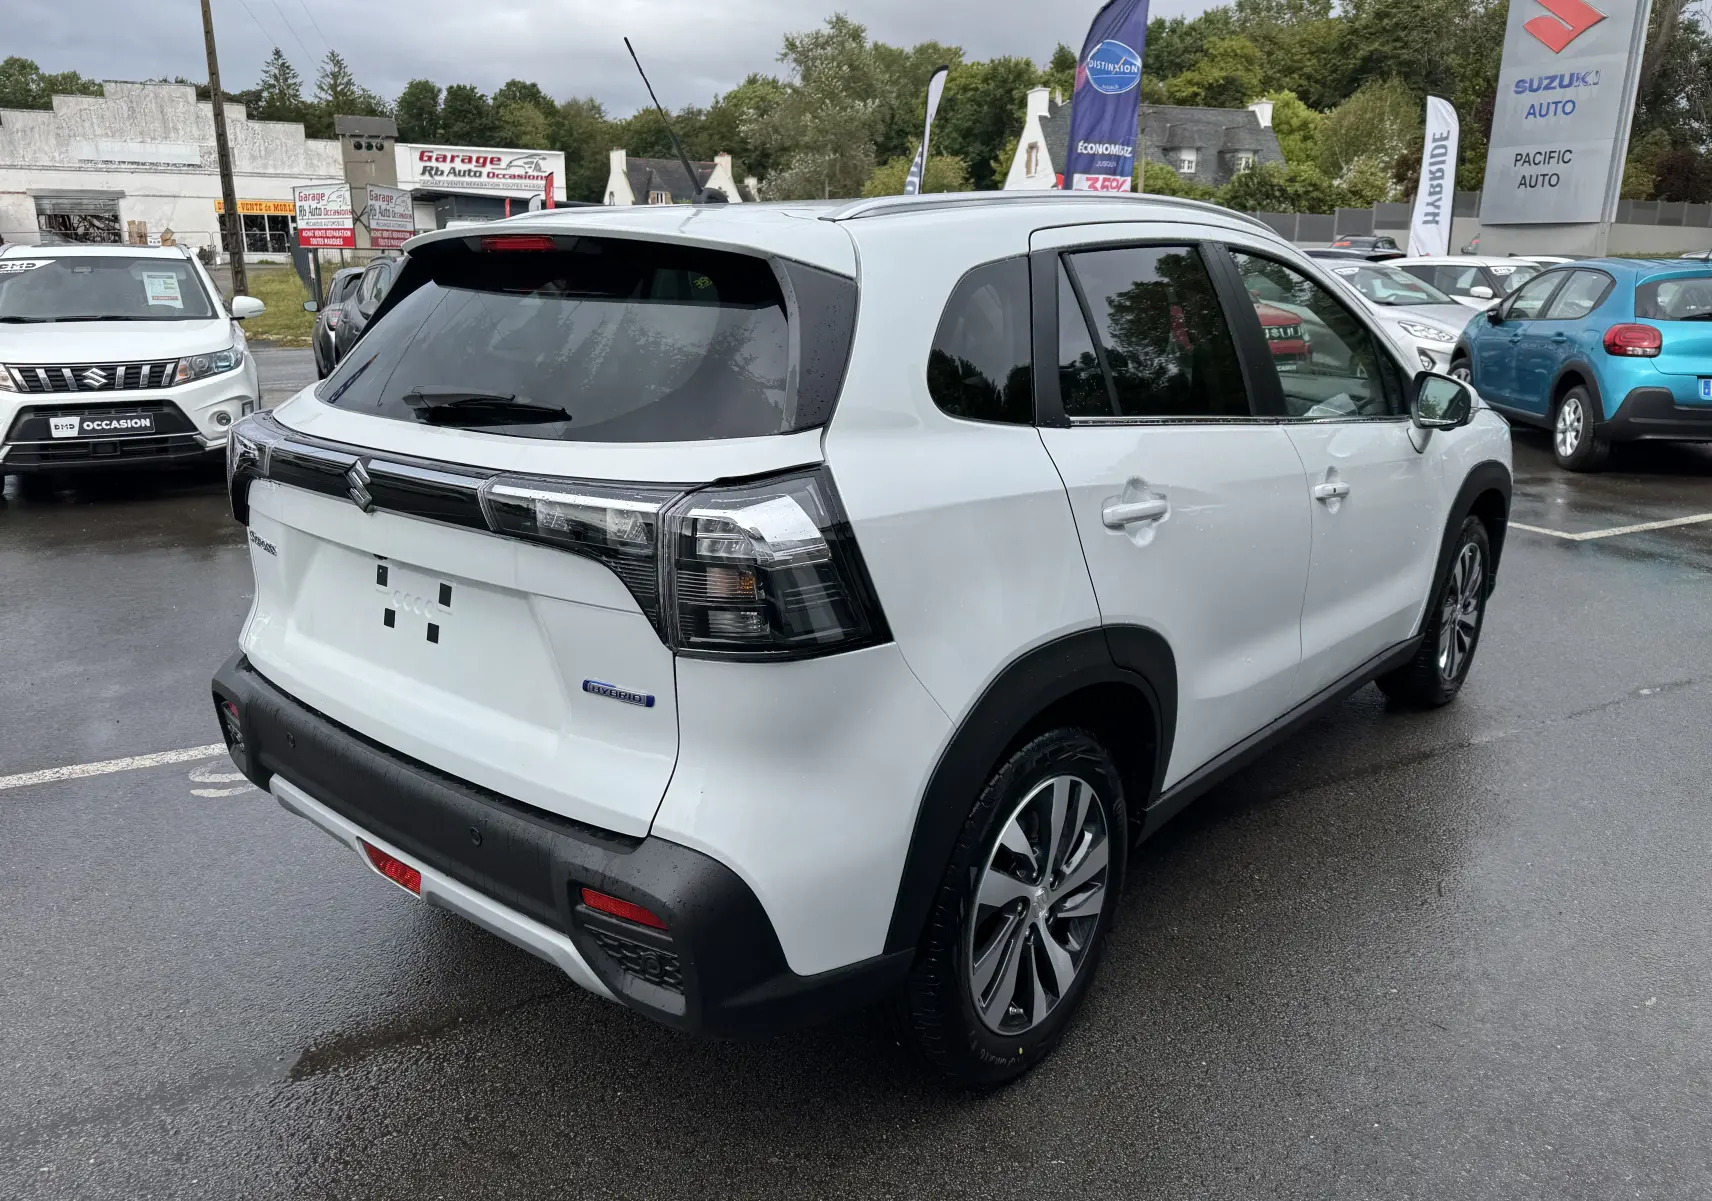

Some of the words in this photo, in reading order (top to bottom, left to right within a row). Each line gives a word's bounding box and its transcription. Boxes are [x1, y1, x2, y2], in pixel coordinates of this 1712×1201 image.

[1088, 59, 1138, 73] DISTINXION
[1513, 69, 1601, 95] SUZUKI
[1524, 99, 1576, 119] AUTO
[419, 150, 502, 168] Garage
[1513, 149, 1573, 167] PACIFIC
[420, 165, 445, 180] Rb
[446, 166, 483, 178] Auto
[1517, 172, 1560, 189] AUTO
[298, 191, 326, 204] Garage
[369, 190, 394, 205] Garage
[298, 205, 307, 219] Rb
[308, 204, 322, 218] Auto
[323, 207, 352, 216] Occasions
[378, 204, 391, 218] Auto
[392, 209, 413, 219] Occasions
[83, 418, 151, 430] OCCASION
[591, 684, 642, 703] HYBRID
